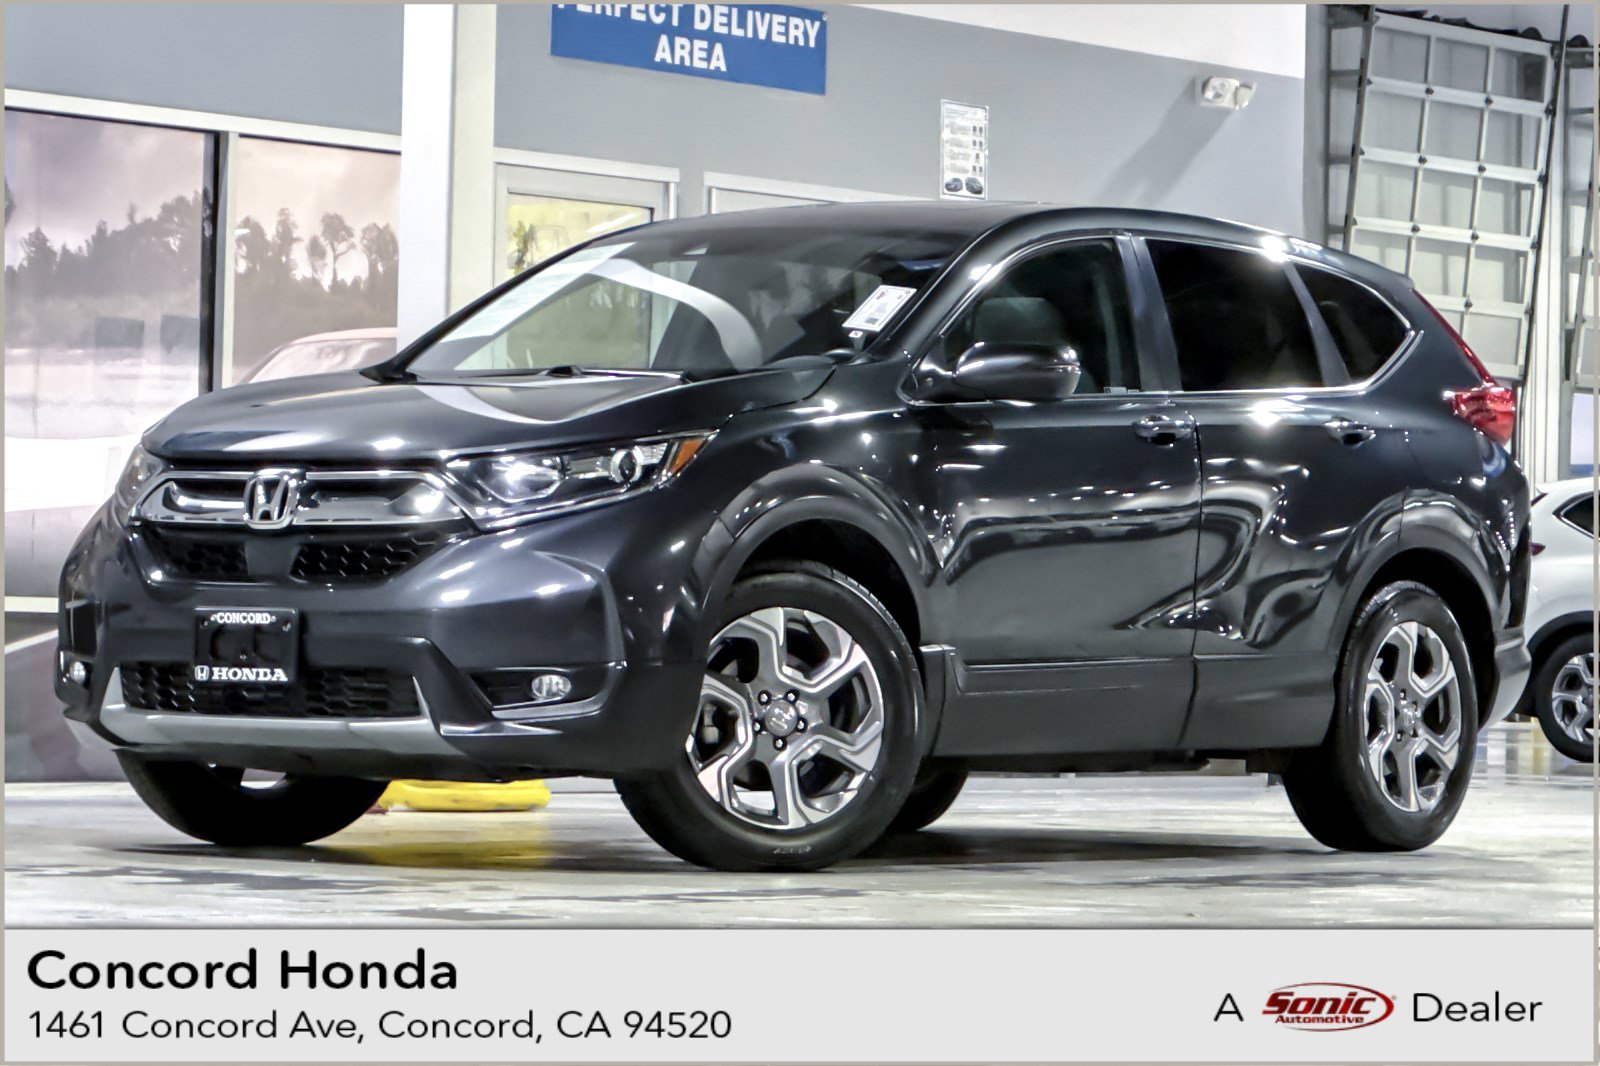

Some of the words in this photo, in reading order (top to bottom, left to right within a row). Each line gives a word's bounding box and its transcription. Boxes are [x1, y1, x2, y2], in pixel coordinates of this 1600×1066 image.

[557, 4, 684, 27] FECT
[694, 5, 821, 48] DELIVERY
[654, 34, 727, 72] AREA
[216, 612, 271, 625] CONCORD
[211, 666, 288, 682] HONDA
